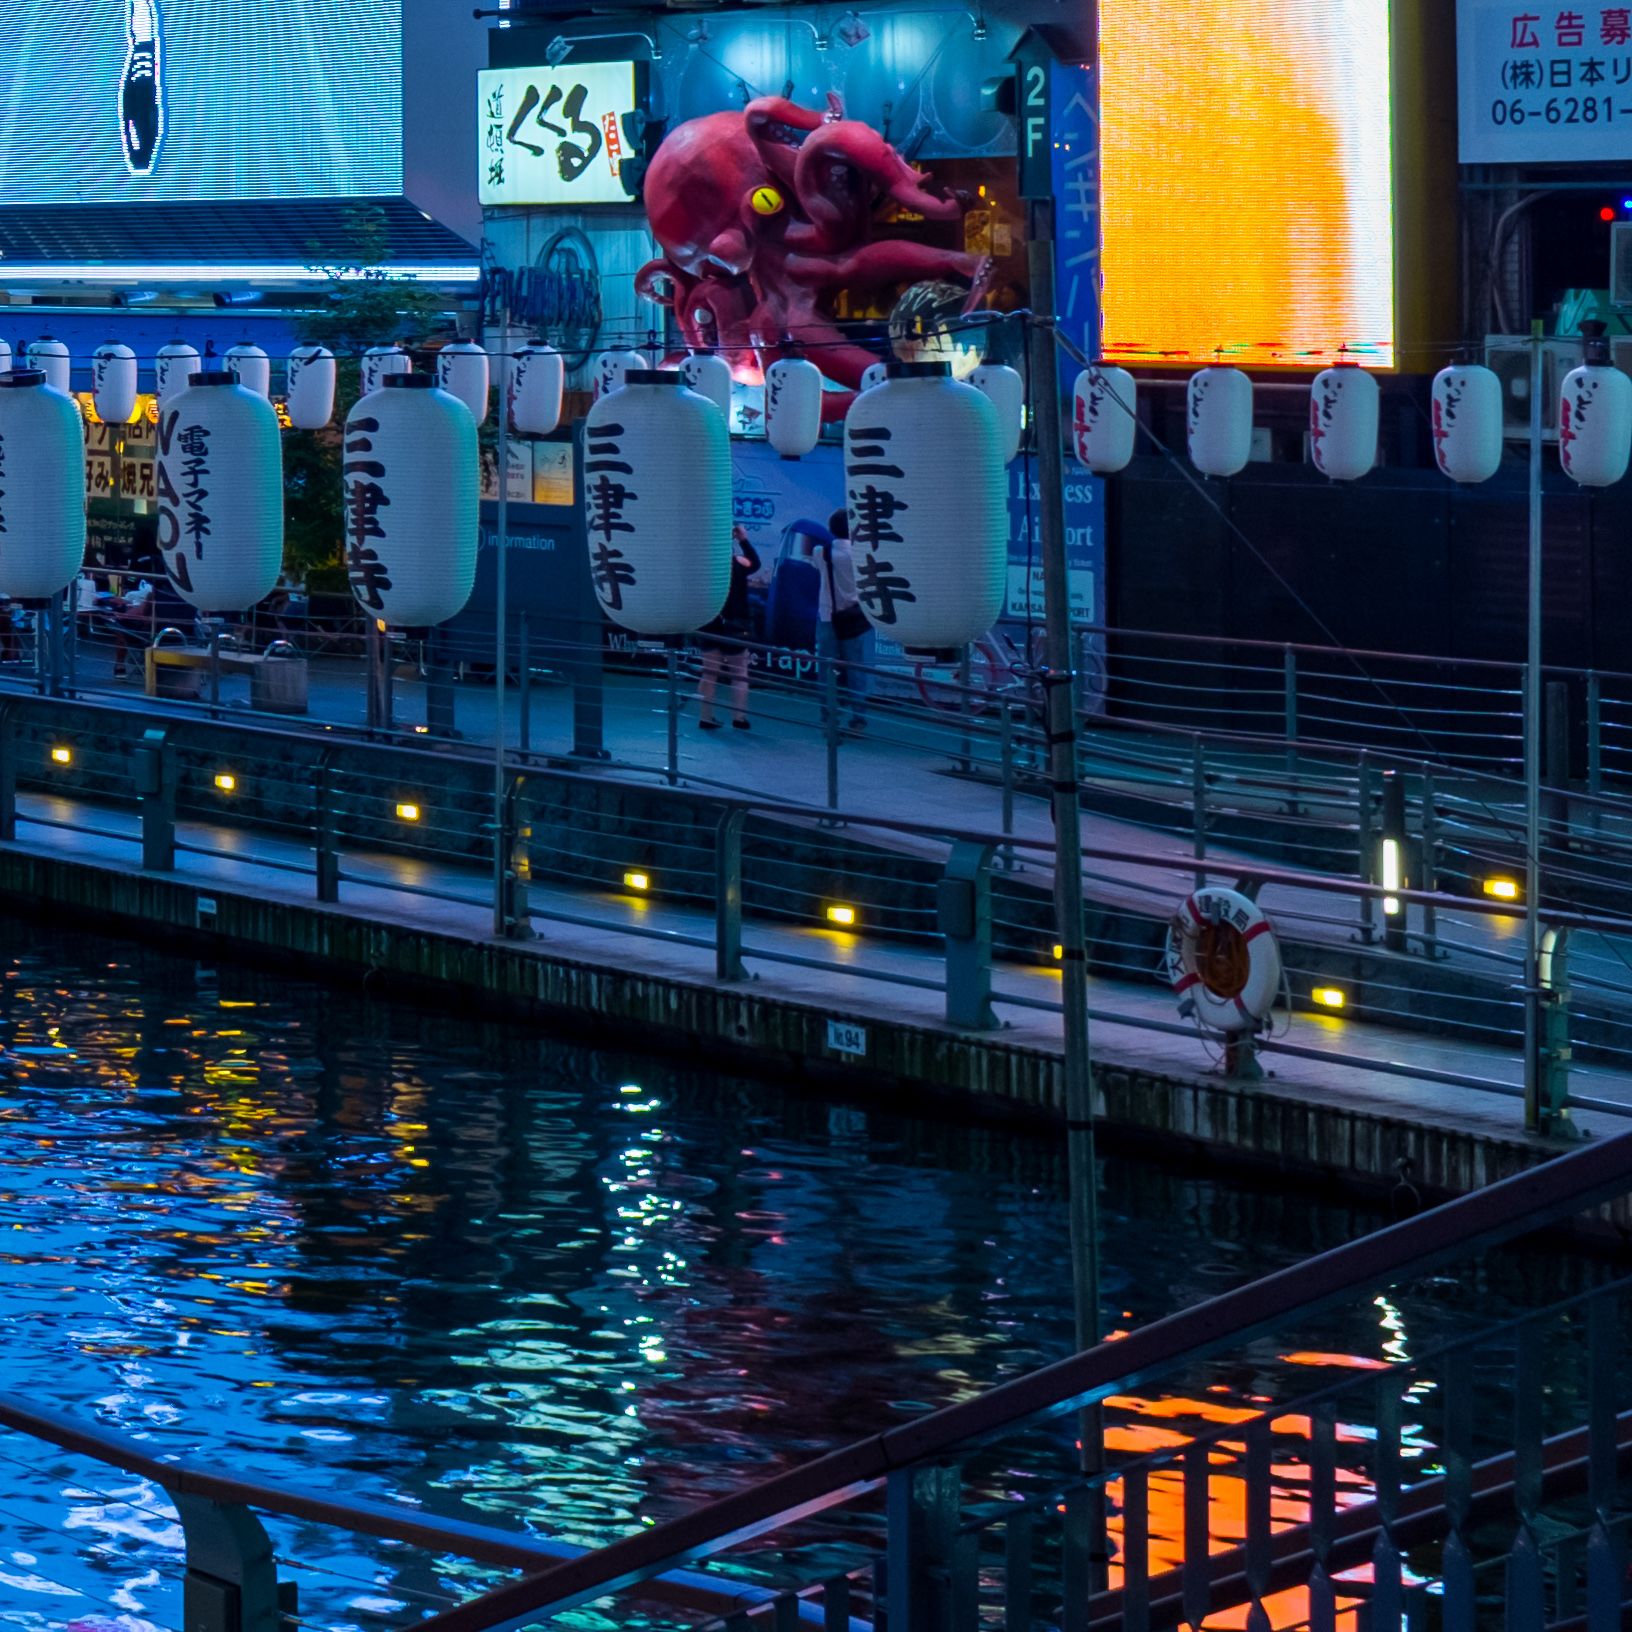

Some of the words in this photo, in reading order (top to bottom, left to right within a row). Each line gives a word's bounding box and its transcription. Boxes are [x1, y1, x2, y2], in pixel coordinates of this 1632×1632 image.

[506, 84, 602, 182] くくる
[1492, 96, 1632, 125] 06-6281-
[177, 425, 212, 561] 電子マネー
[344, 416, 392, 611] 三津寺
[584, 423, 637, 611] 三津寺
[848, 426, 917, 625] 三津寺
